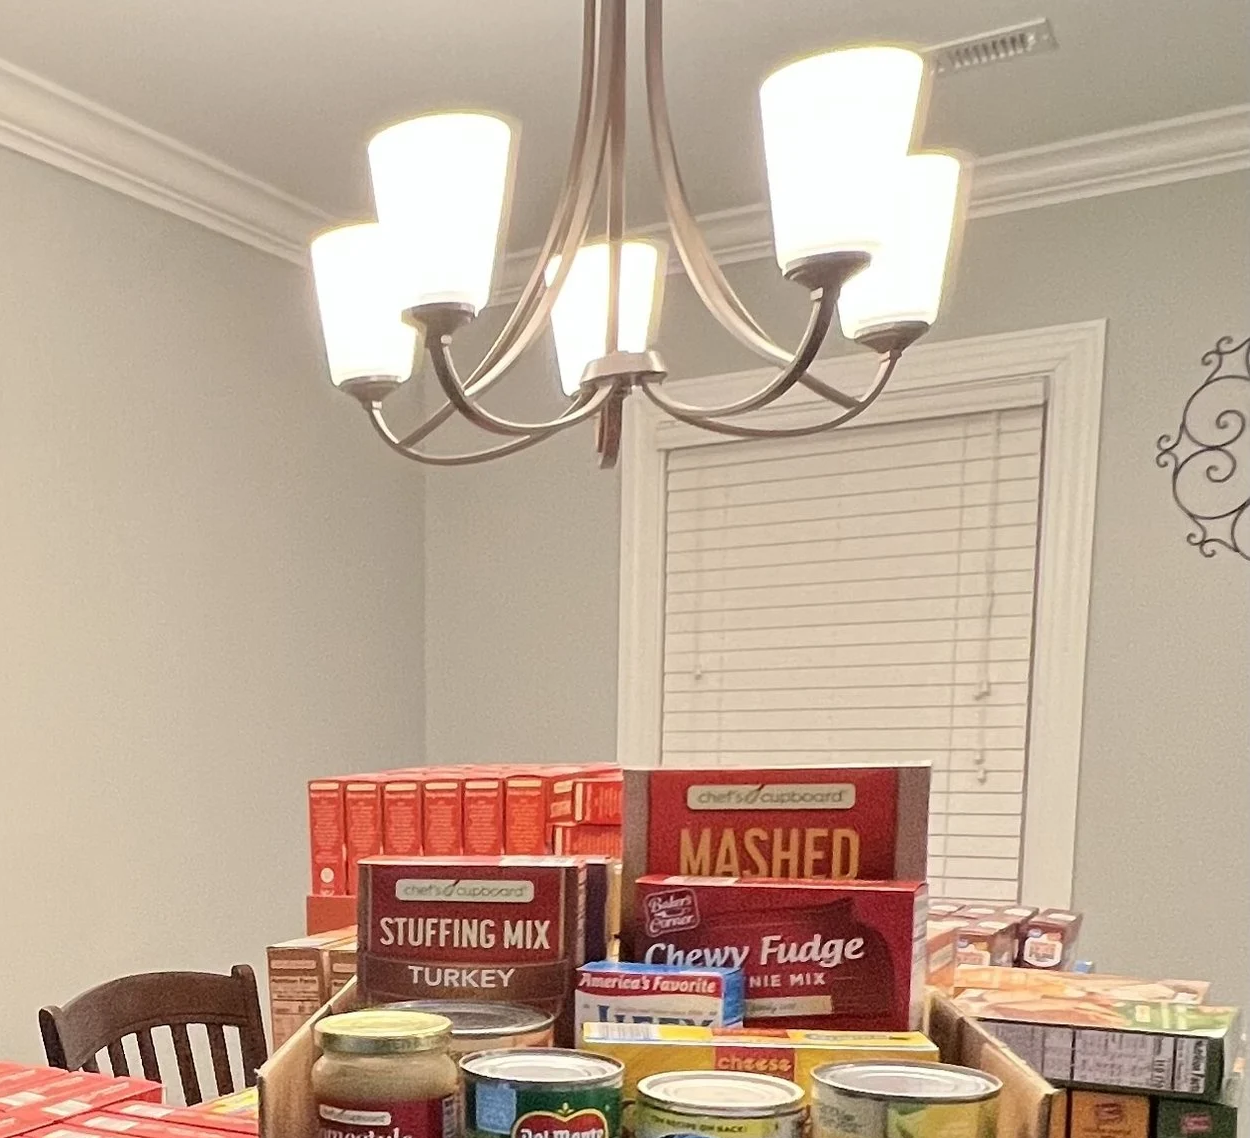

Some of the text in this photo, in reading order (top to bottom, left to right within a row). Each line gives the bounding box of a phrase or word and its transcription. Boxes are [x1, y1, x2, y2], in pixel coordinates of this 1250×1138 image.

[758, 789, 843, 806] cupboard
[679, 827, 861, 880] MASHED
[379, 917, 550, 949] STUFFING MIX
[644, 934, 865, 969] Chewy Fudge
[408, 965, 516, 988] TURKEY
[579, 973, 716, 994] America's Favorite
[789, 972, 826, 987] MIX
[717, 1056, 792, 1072] cheese
